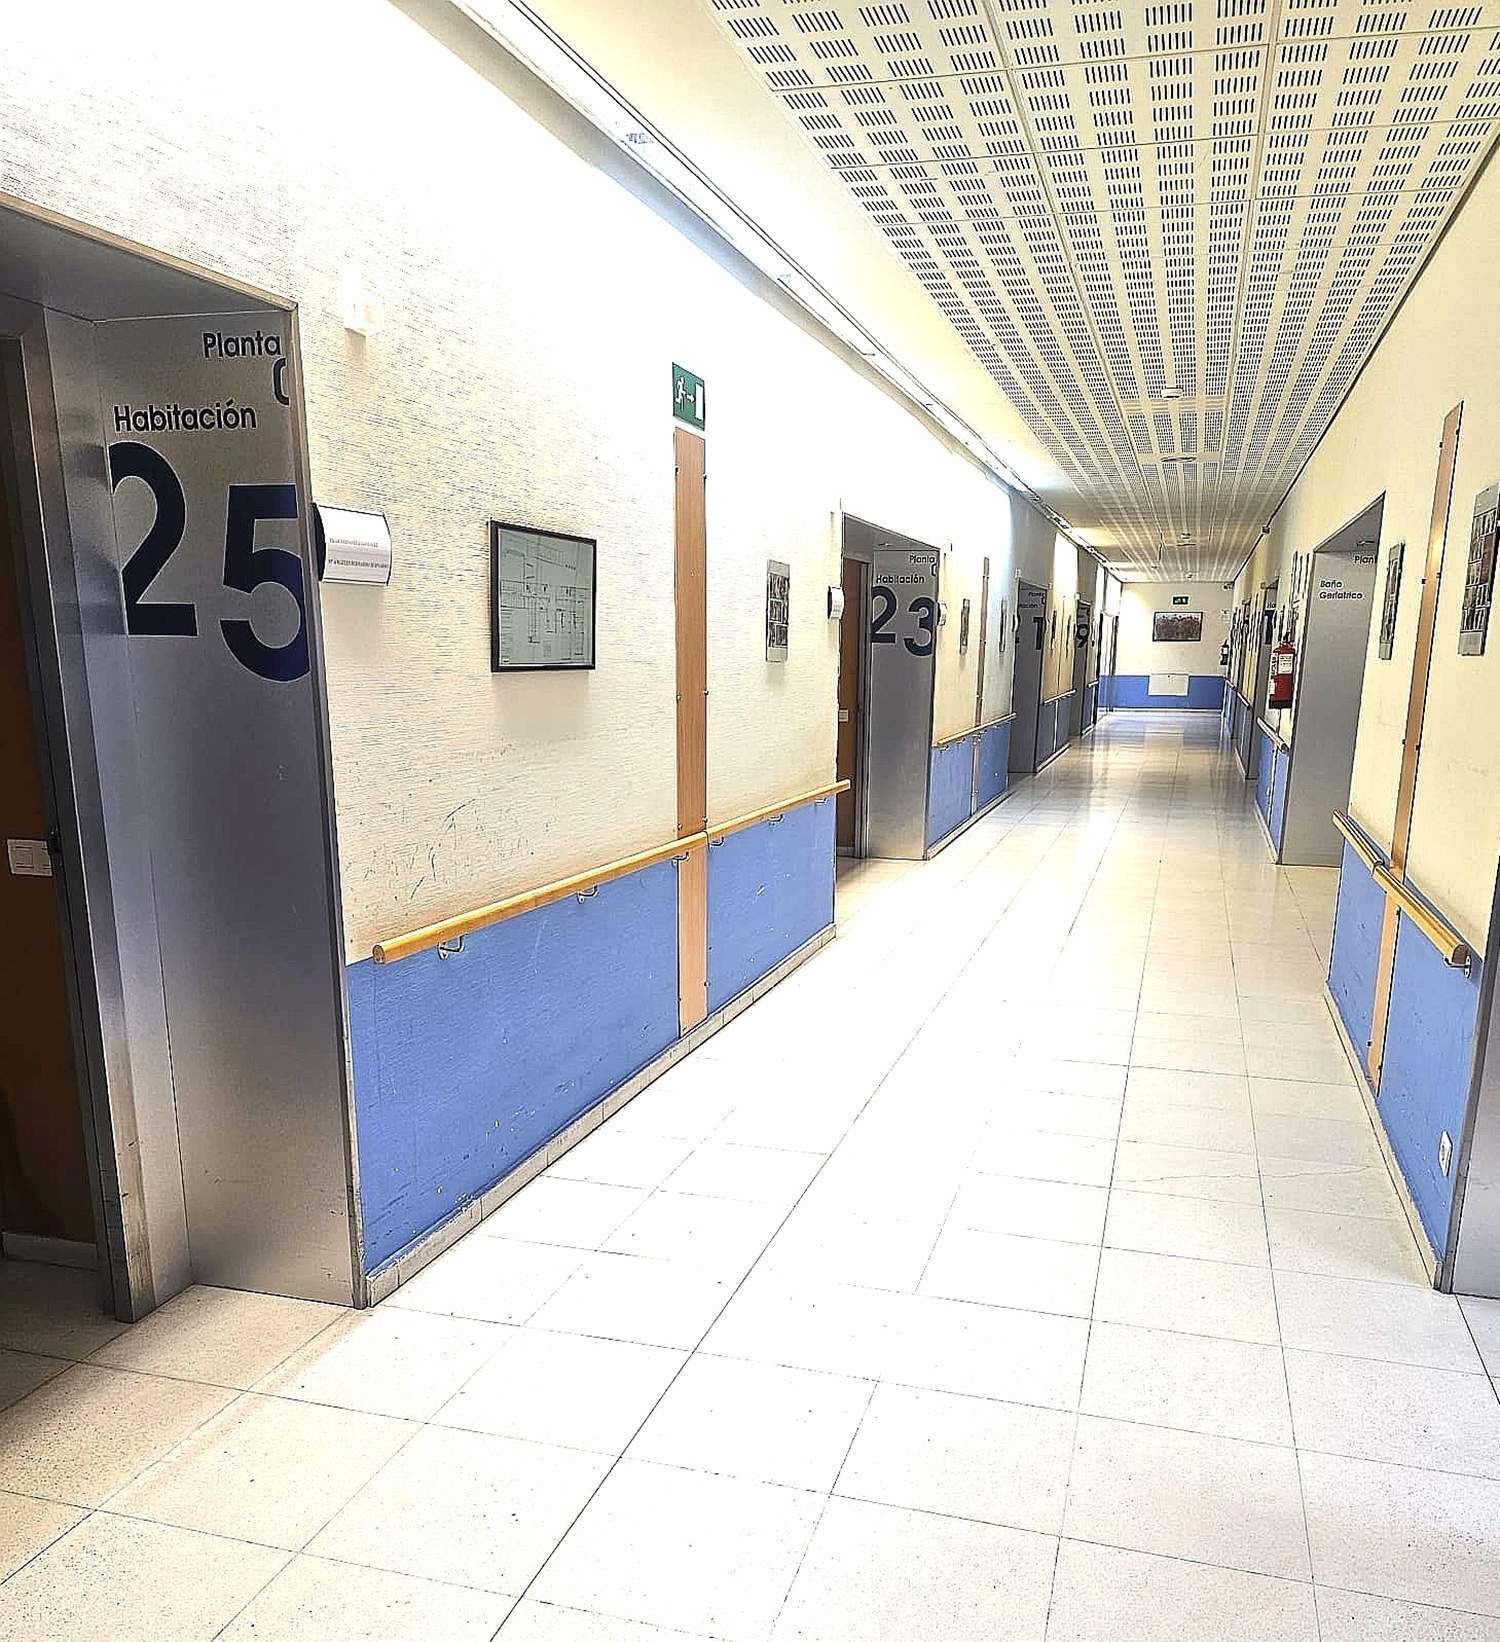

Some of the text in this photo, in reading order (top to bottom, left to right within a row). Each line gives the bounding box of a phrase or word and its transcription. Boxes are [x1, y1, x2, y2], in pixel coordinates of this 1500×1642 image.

[202, 330, 281, 358] Planta
[113, 399, 257, 432] Habitación
[108, 440, 311, 683] 25
[909, 554, 935, 563] Planta
[876, 574, 925, 584] Habitación
[872, 585, 935, 657] 23
